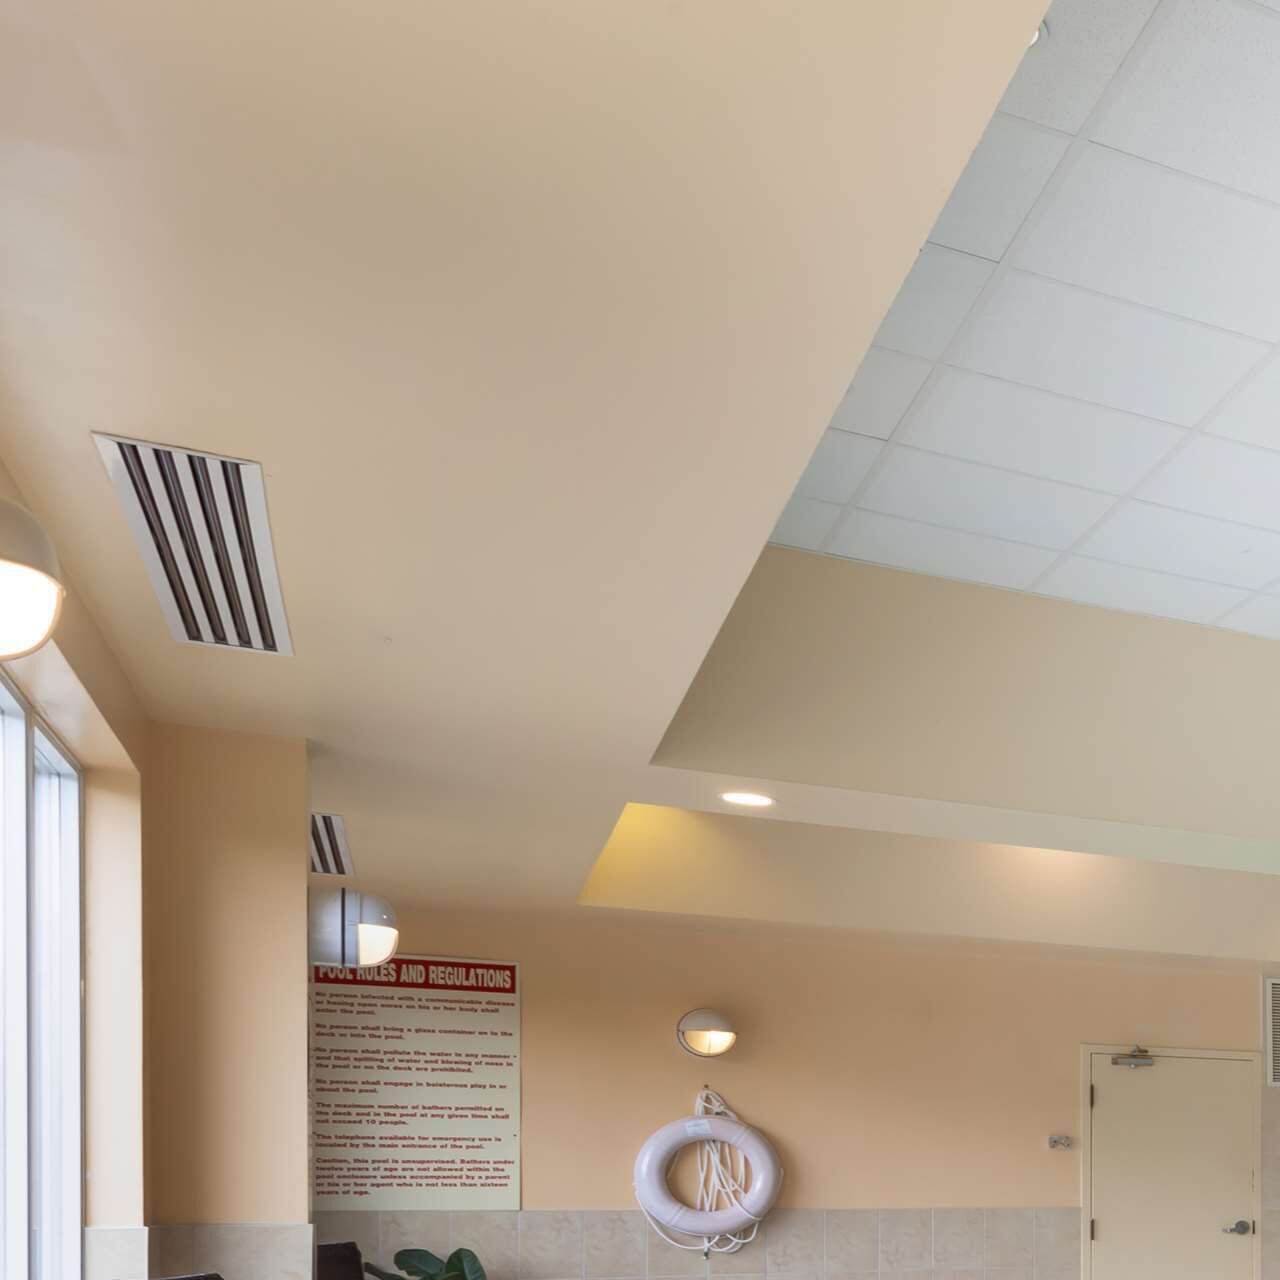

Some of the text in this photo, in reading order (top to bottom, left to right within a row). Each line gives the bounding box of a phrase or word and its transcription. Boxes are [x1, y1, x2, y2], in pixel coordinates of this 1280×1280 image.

[320, 963, 512, 988] POOL RULES AND REGULATIONS
